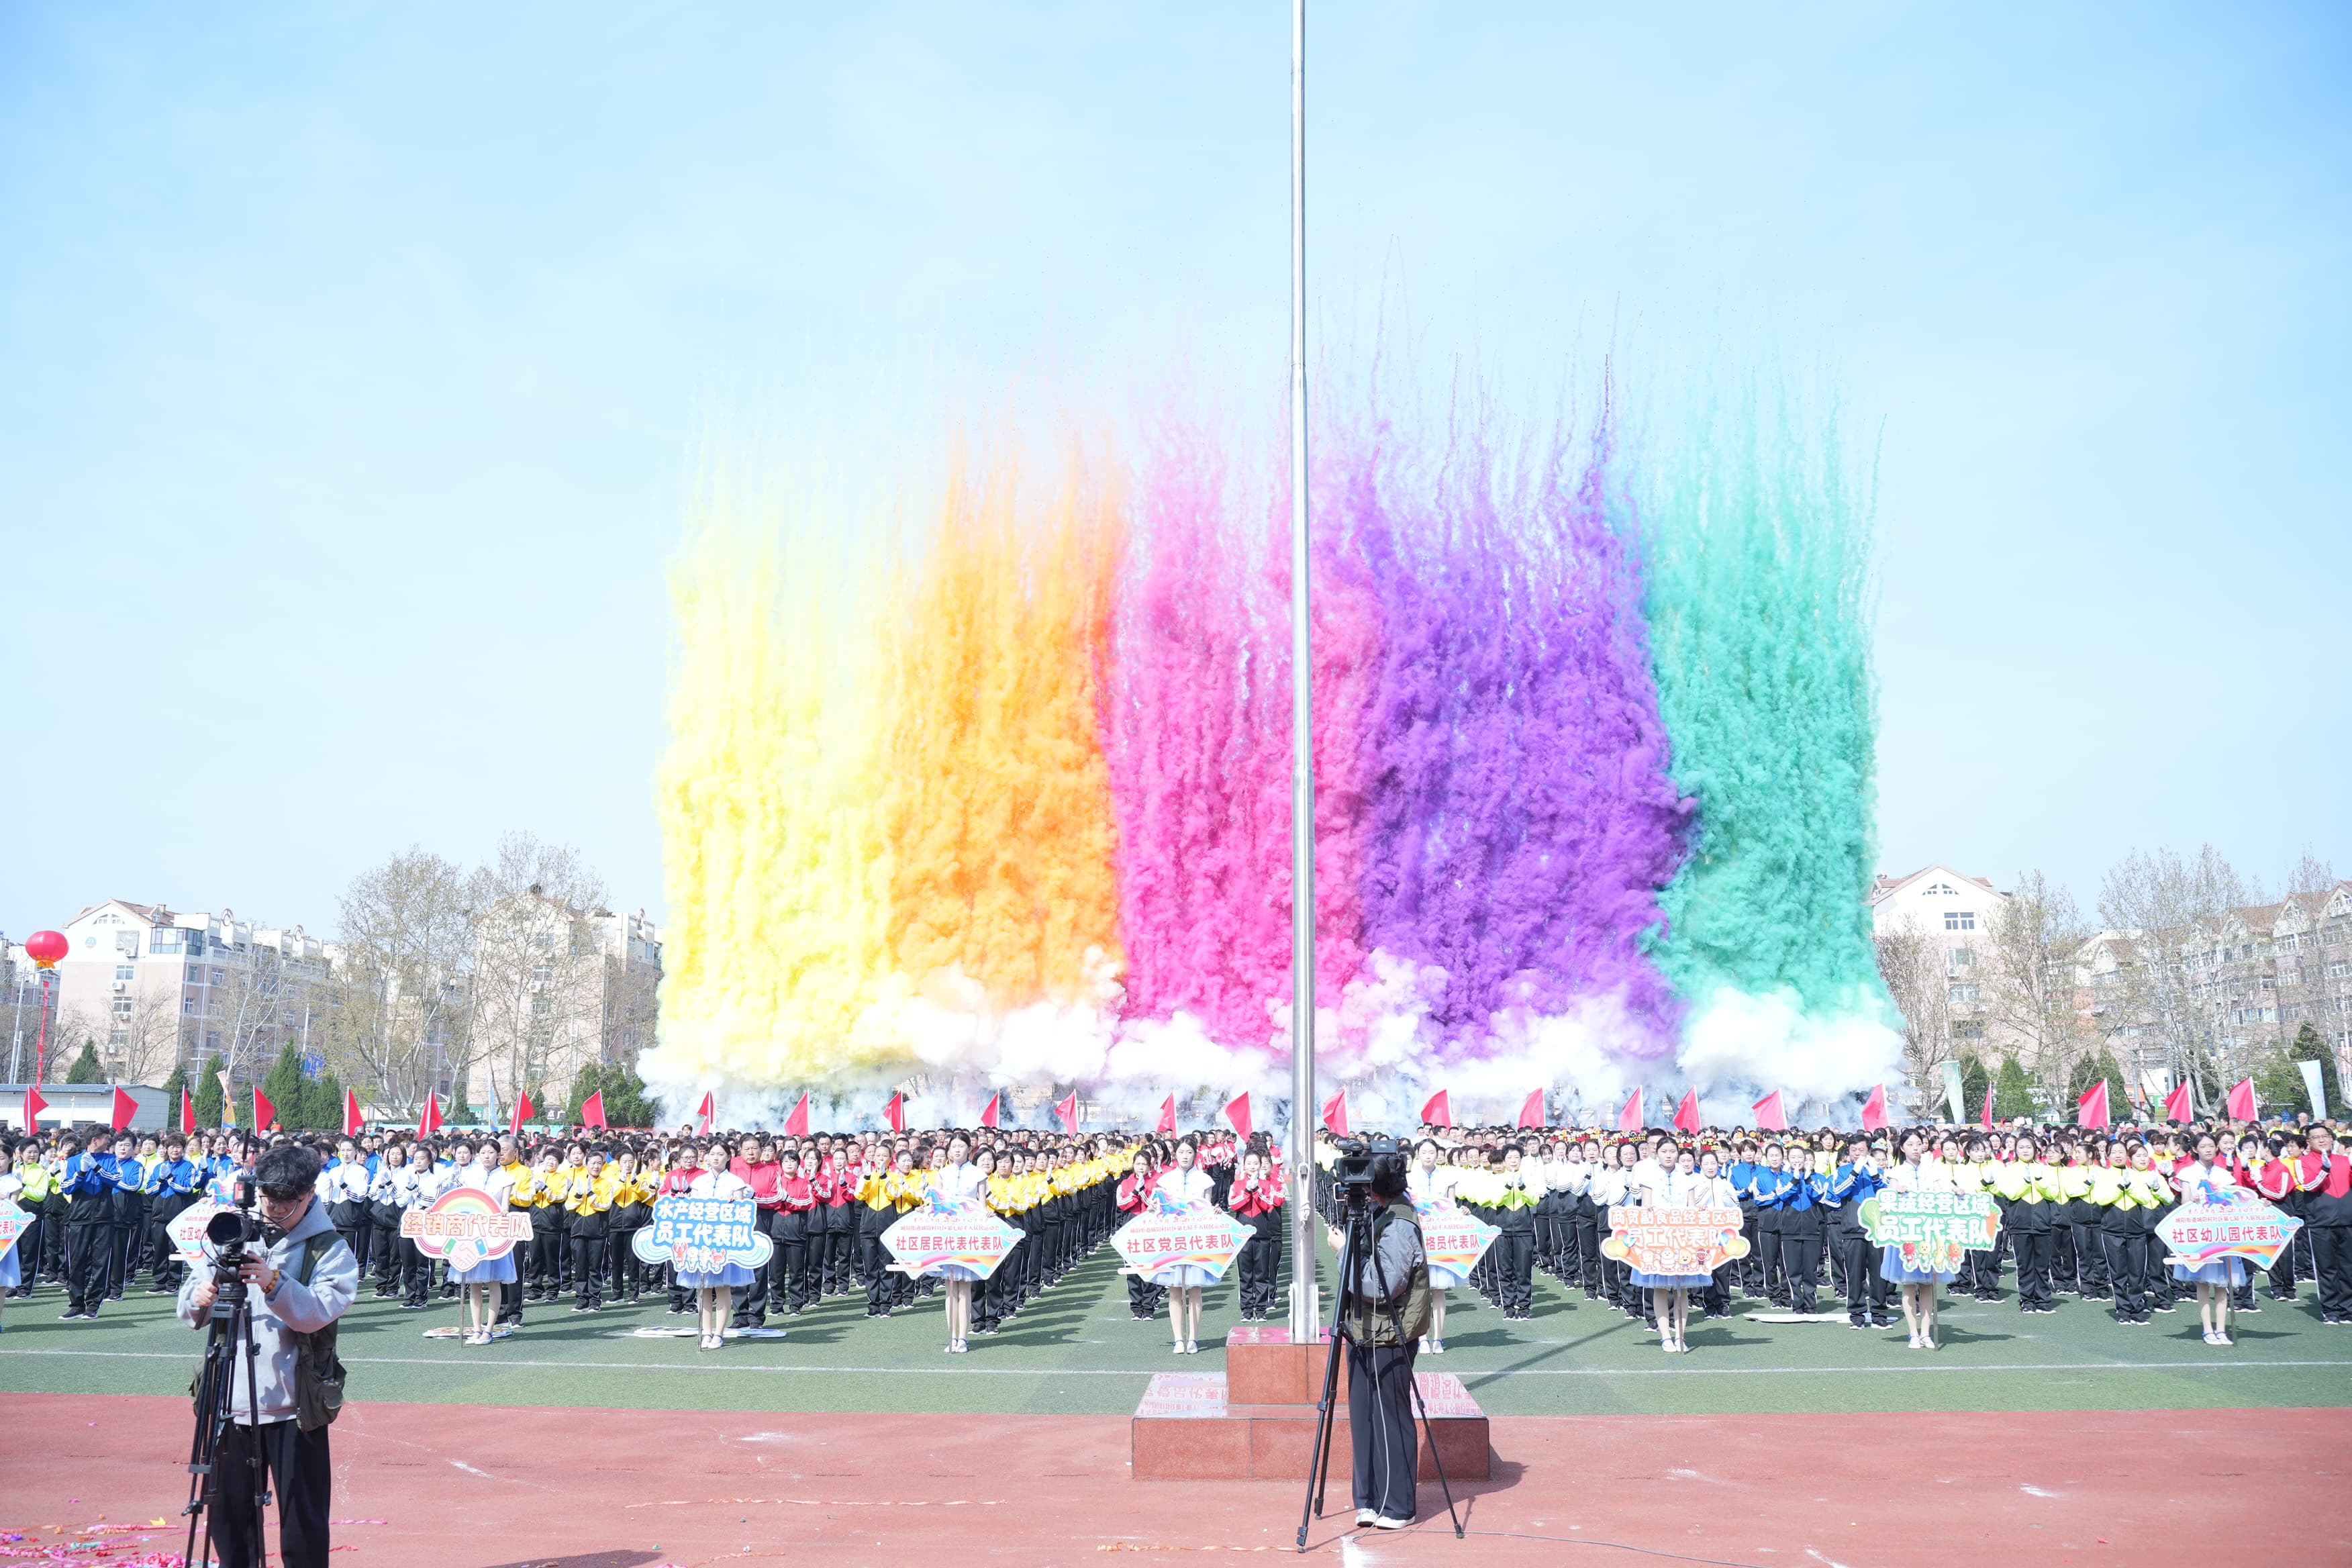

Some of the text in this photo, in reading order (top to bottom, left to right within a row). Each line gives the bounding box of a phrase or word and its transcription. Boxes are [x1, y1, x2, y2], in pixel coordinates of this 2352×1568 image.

[657, 1200, 752, 1224] 水产经营区域
[1879, 1191, 1990, 1216] 果蔬经营区域
[403, 1212, 530, 1238] 经销商代表队
[1612, 1209, 1740, 1225] 商贸副食品经营区域
[0, 1220, 15, 1234] 表队
[655, 1221, 752, 1248] 员工代表队
[1879, 1216, 1992, 1244] 员工代表队
[2172, 1226, 2283, 1242] 社区幼儿园代表队
[896, 1236, 1003, 1251] 社区居民代表代表队
[1127, 1234, 1235, 1253] 社区党员代表队
[1426, 1234, 1480, 1251] 格员代表队
[1626, 1228, 1728, 1247] 员工代表队
